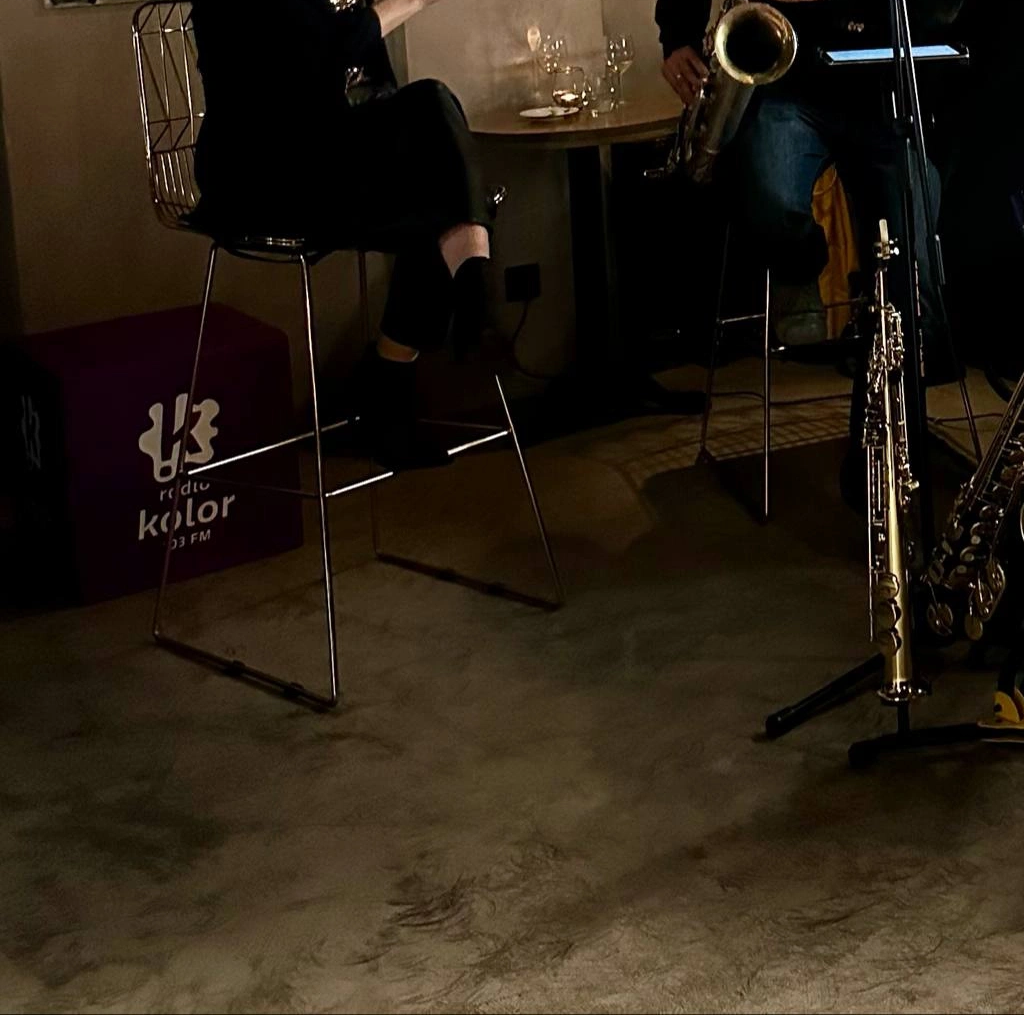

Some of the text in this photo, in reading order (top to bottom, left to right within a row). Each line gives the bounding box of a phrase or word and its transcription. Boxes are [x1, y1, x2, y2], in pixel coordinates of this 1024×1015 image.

[138, 494, 235, 541] kolor
[164, 528, 211, 551] 03 FM
